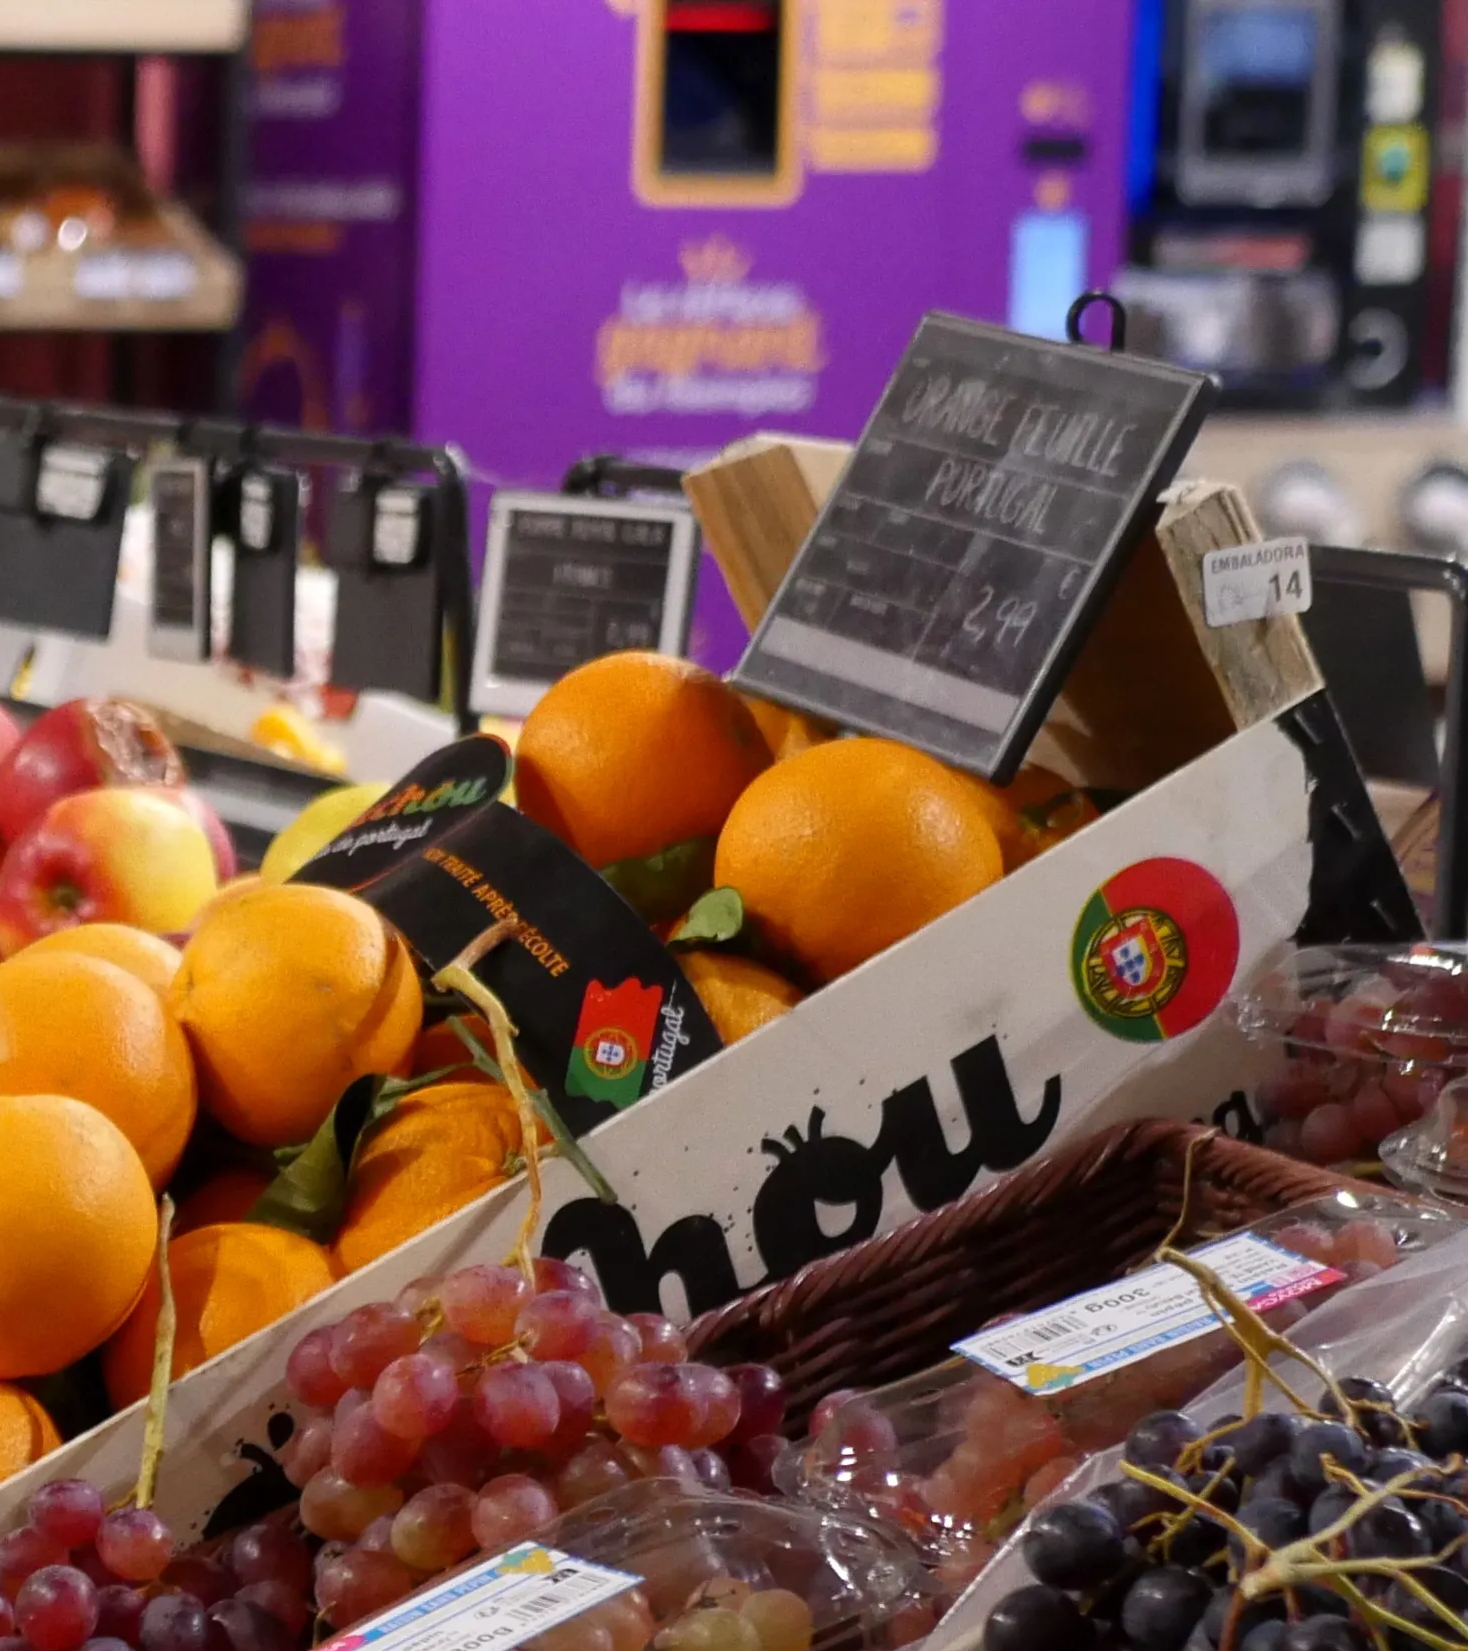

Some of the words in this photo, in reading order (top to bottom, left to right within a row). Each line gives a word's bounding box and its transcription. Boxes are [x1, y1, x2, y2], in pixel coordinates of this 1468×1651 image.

[926, 455, 1059, 533] PORTUGAL
[1211, 544, 1305, 575] EMBALADORA
[1269, 569, 1303, 603] 14
[1081, 1285, 1152, 1315] 300g
